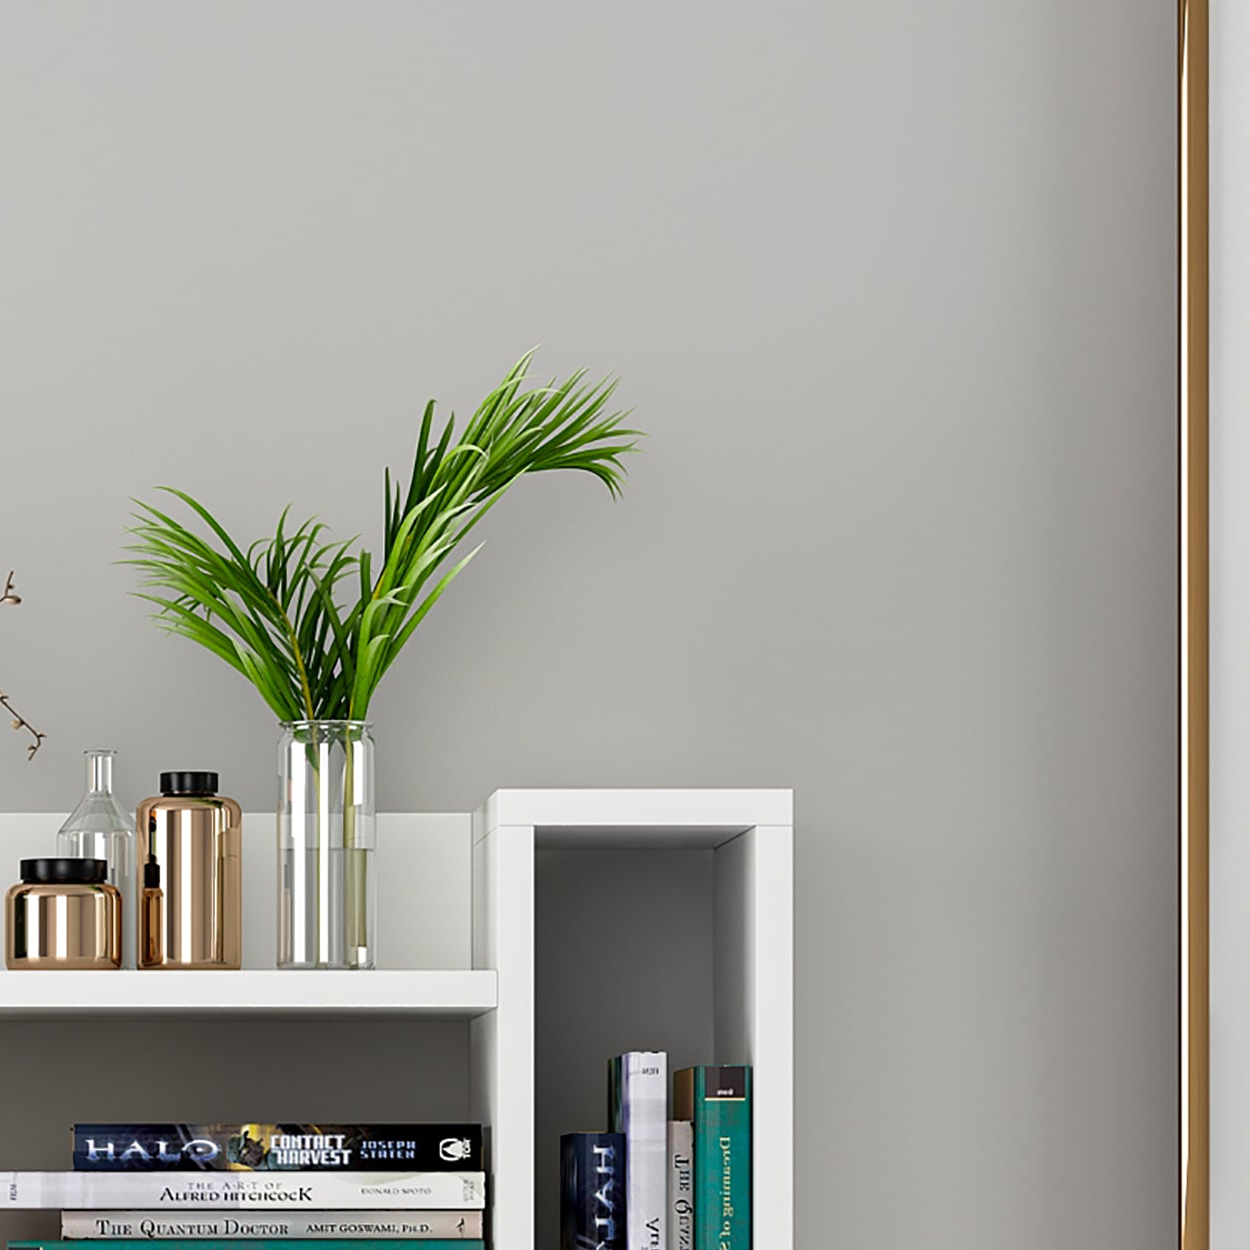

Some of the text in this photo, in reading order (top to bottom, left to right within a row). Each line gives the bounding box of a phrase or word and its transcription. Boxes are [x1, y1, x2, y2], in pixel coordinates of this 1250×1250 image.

[270, 1135, 345, 1149] CONTACT
[360, 1141, 416, 1149] JOSEPH
[85, 1139, 221, 1161] HALO
[360, 1150, 415, 1159] STATEN
[272, 1150, 352, 1165] HARVEST
[188, 1182, 213, 1190] THE
[264, 1182, 282, 1190] OF
[160, 1187, 312, 1201] ALFRED HITCHCOCK
[96, 1219, 289, 1239] THE QUANTUM DOCTOR
[306, 1224, 337, 1233] AMIT
